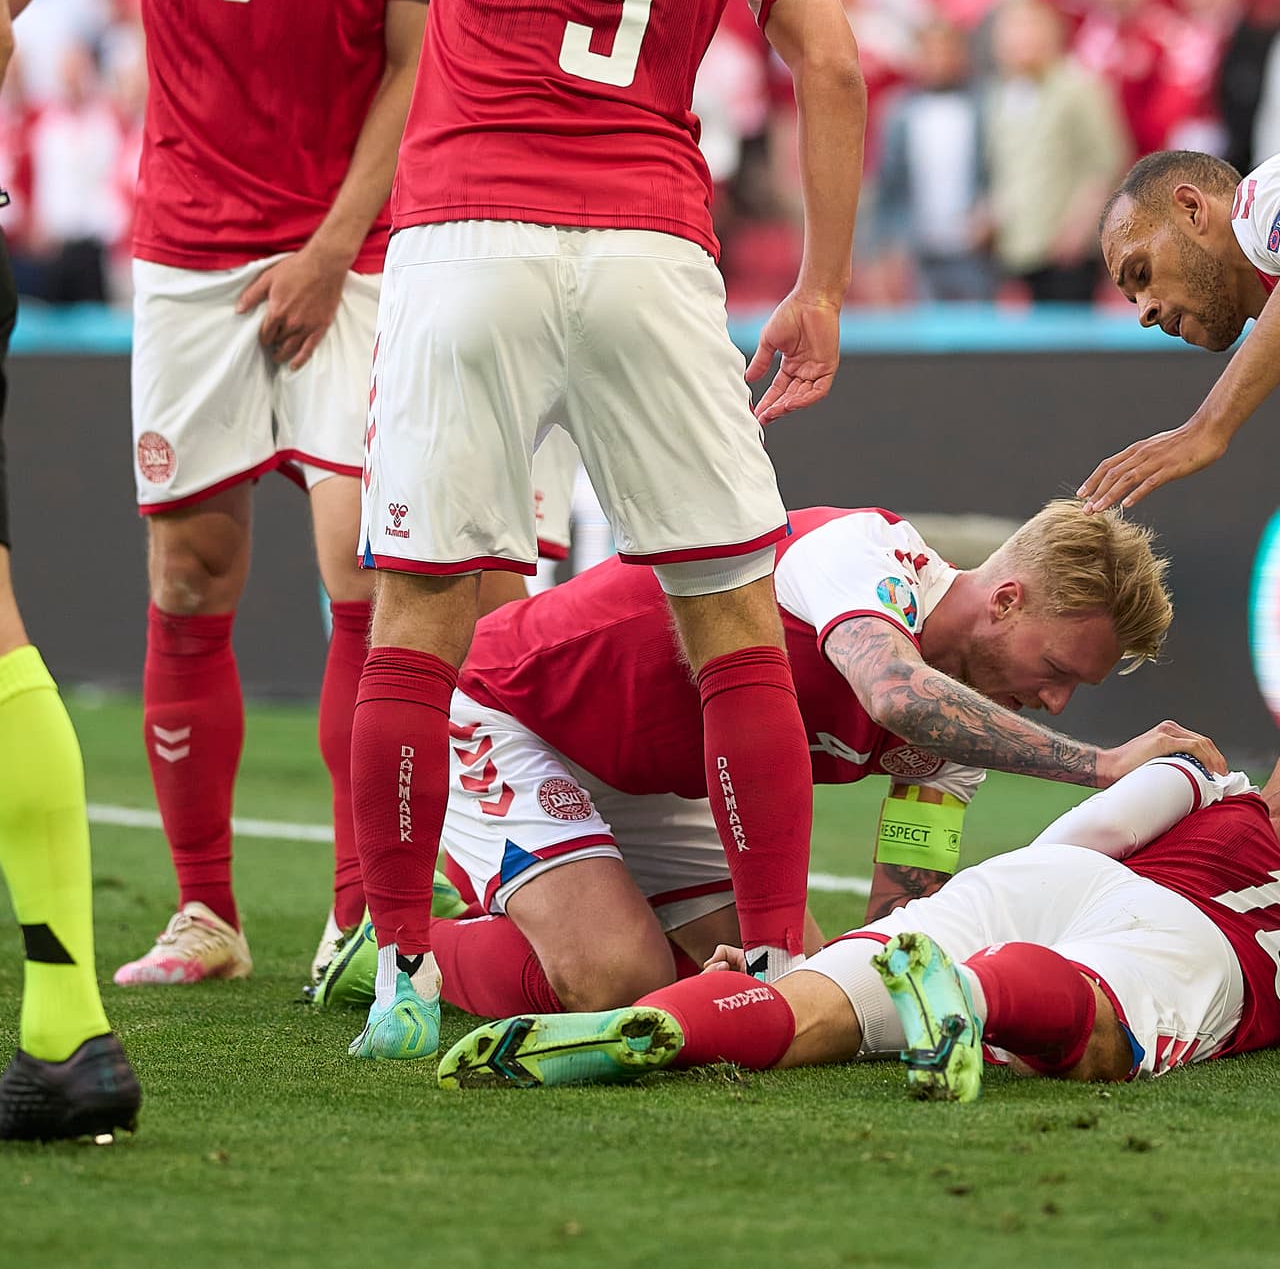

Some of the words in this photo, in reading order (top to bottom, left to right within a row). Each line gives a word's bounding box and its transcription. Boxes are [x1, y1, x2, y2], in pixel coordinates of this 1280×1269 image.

[384, 525, 410, 539] hummel
[398, 744, 414, 843] DANMARK
[548, 791, 582, 809] DBU
[716, 756, 752, 853] DANMARK
